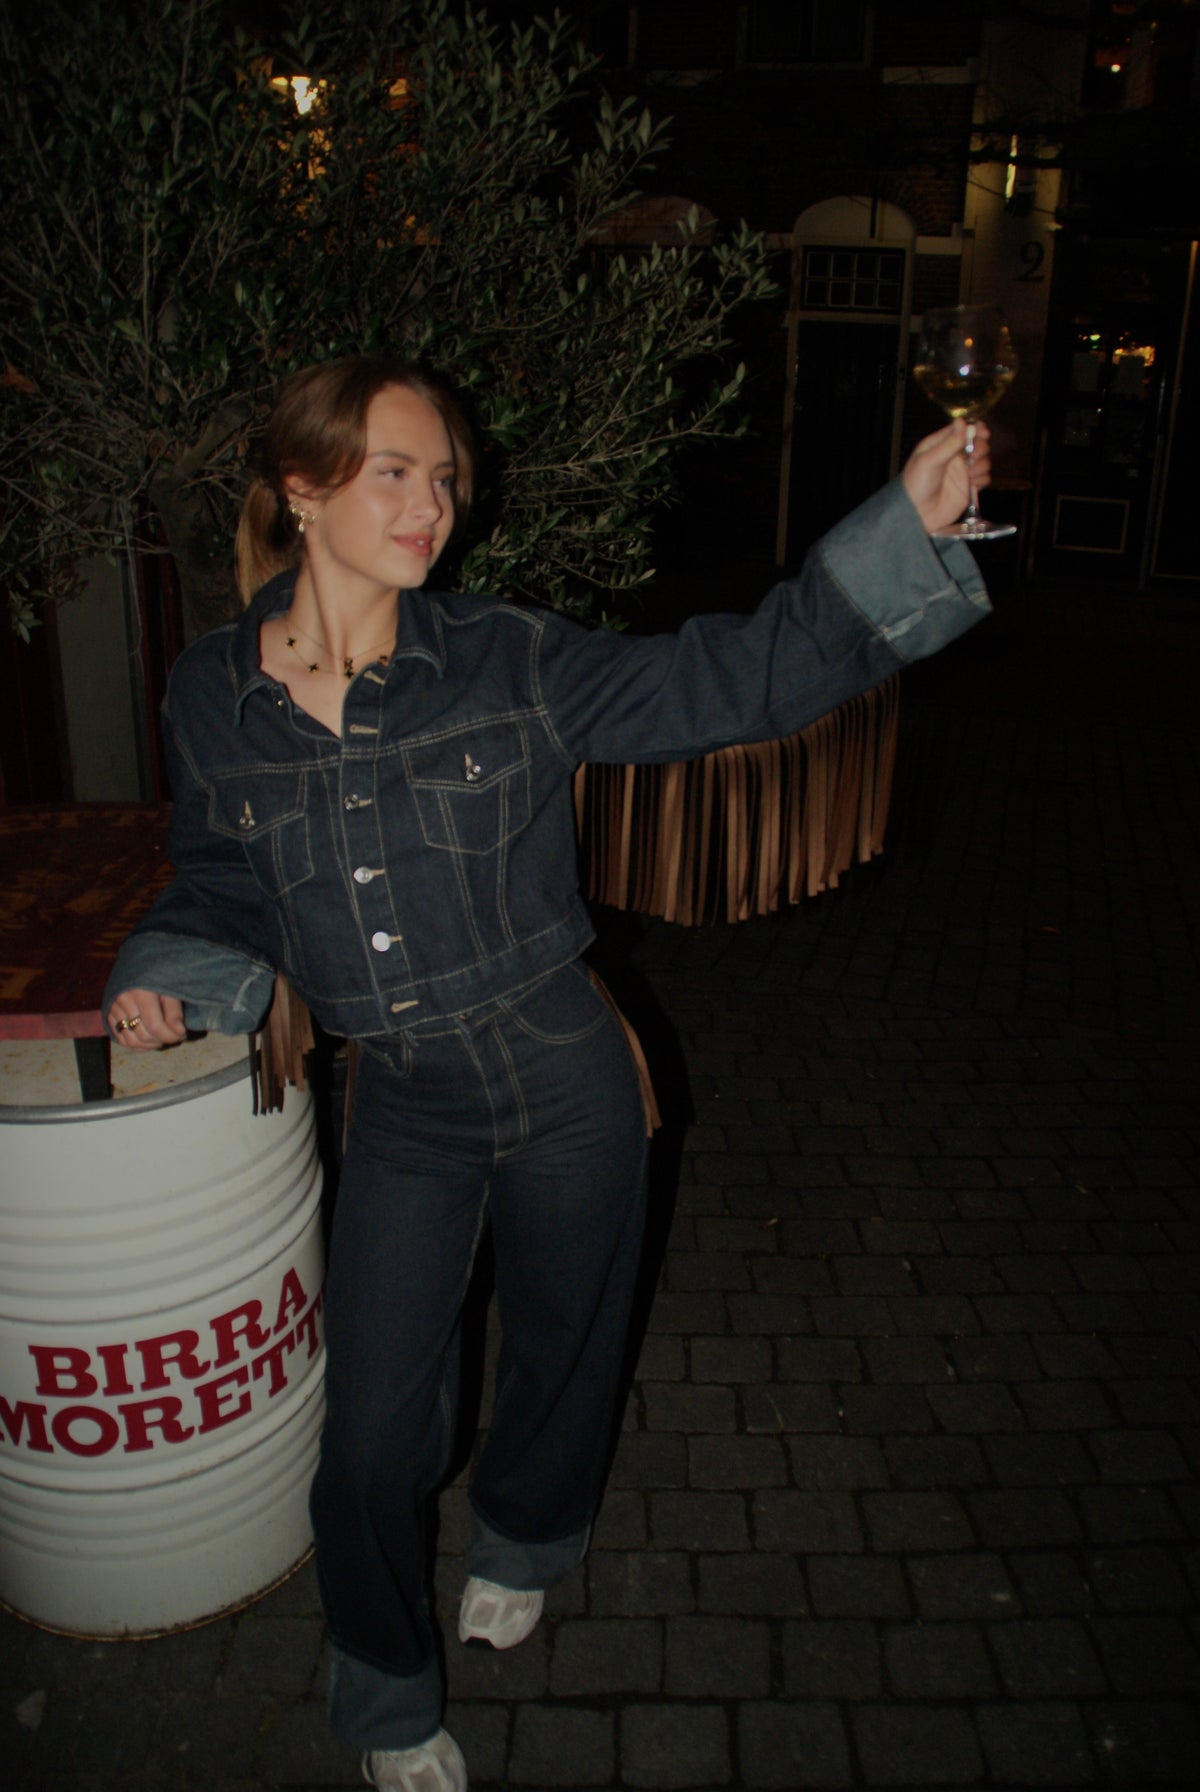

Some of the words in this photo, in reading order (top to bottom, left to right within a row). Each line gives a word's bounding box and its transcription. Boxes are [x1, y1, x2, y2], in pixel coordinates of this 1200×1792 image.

[1017, 241, 1045, 282] 2
[0, 1283, 324, 1457] MORETT
[28, 1267, 307, 1397] BIRRA
